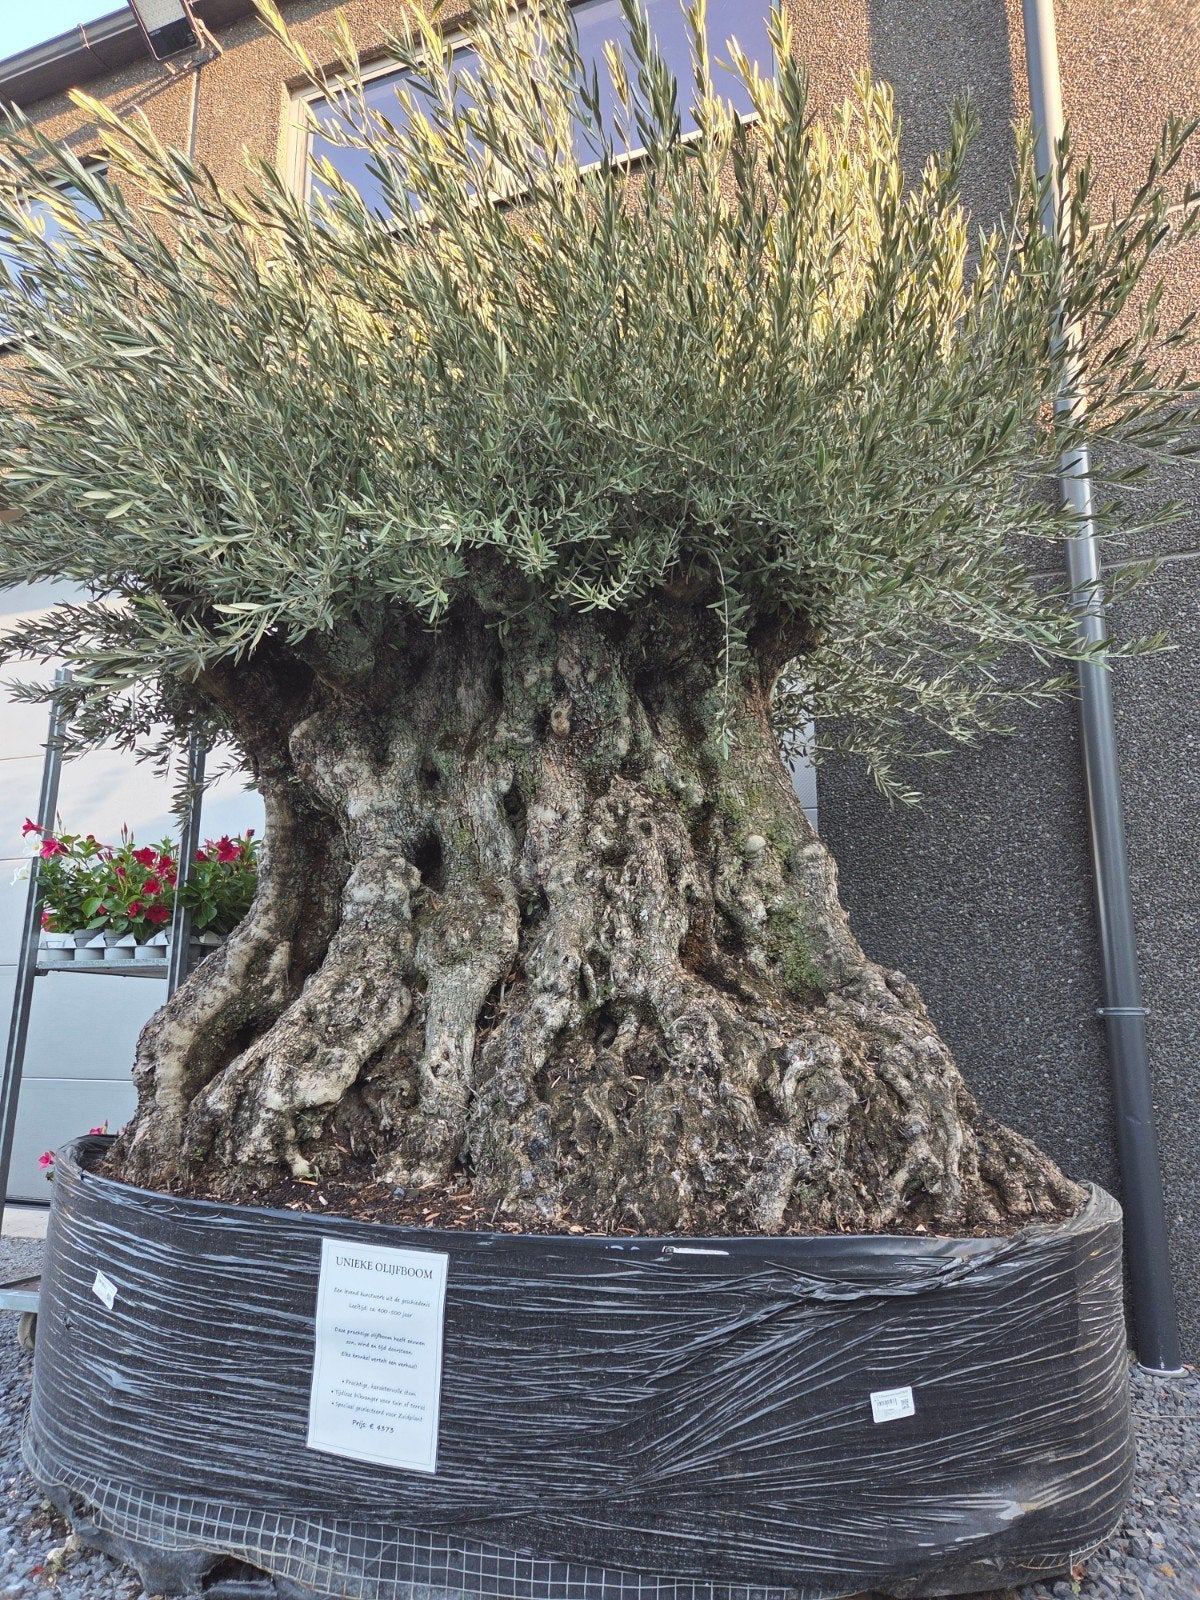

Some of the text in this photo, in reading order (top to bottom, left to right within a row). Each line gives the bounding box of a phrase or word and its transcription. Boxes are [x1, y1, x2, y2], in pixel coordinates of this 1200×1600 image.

[336, 1256, 432, 1279] UNIEKE OLIJFBOOM
[360, 1291, 385, 1301] kunstwerk
[401, 1298, 430, 1308] geschiedenis
[371, 1332, 392, 1340] olijfboom
[371, 1384, 402, 1394] karaktervolle
[410, 1402, 425, 1411] terras
